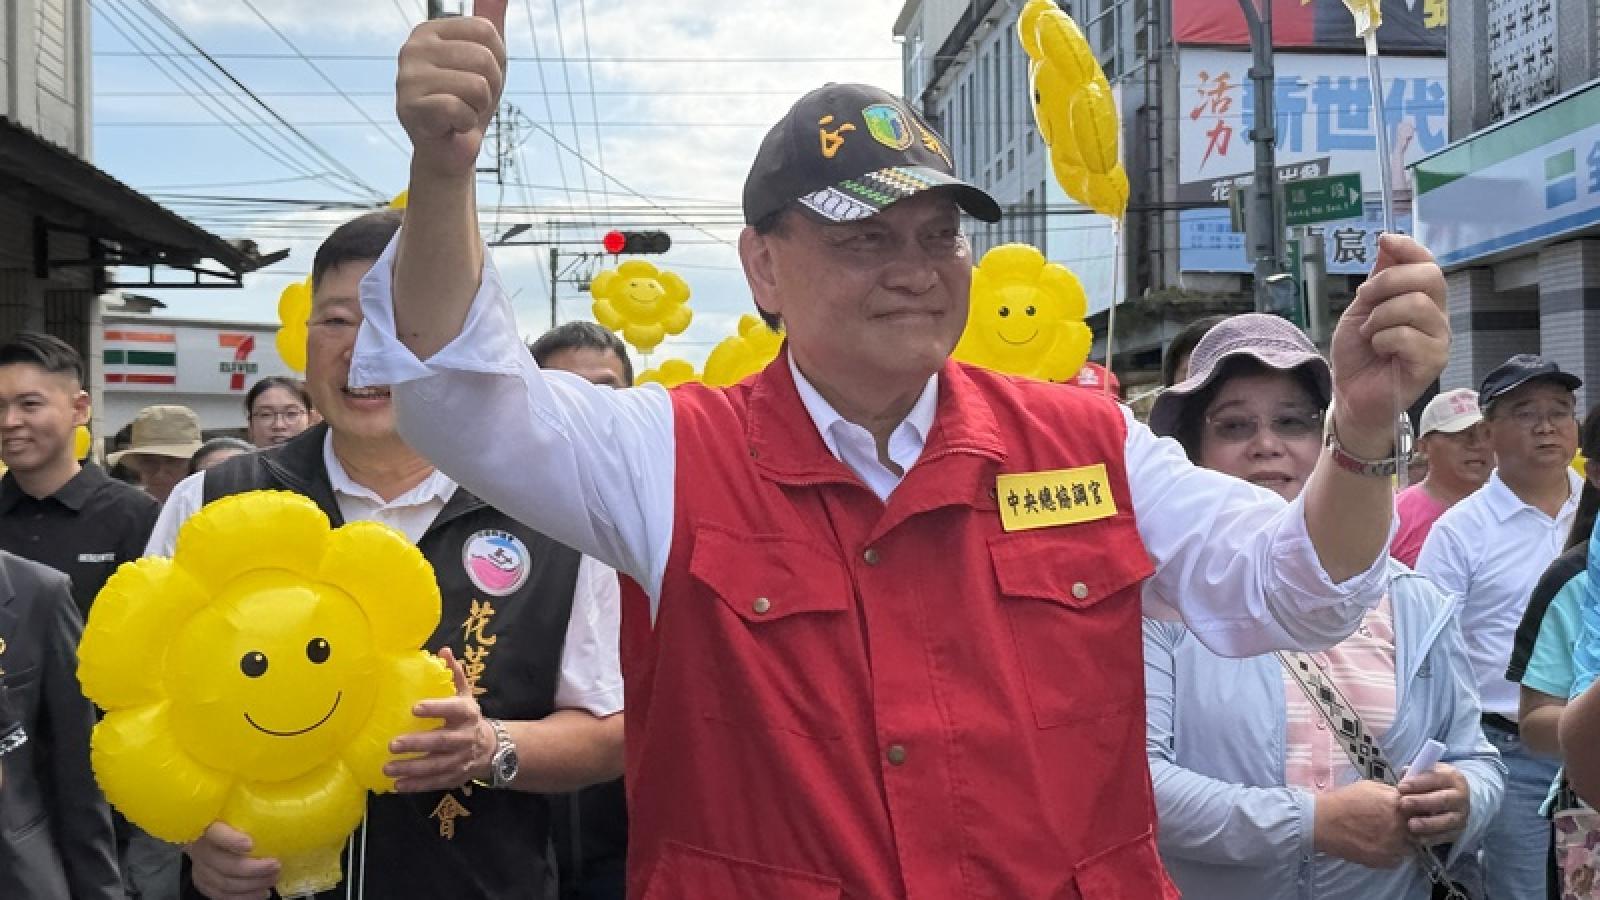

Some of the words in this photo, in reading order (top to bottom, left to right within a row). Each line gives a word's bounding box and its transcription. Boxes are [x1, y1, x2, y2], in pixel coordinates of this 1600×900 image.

[1190, 71, 1237, 171] 活力
[1240, 75, 1445, 153] 新世代
[218, 334, 255, 390] 7
[1007, 479, 1103, 517] 中央總協調官
